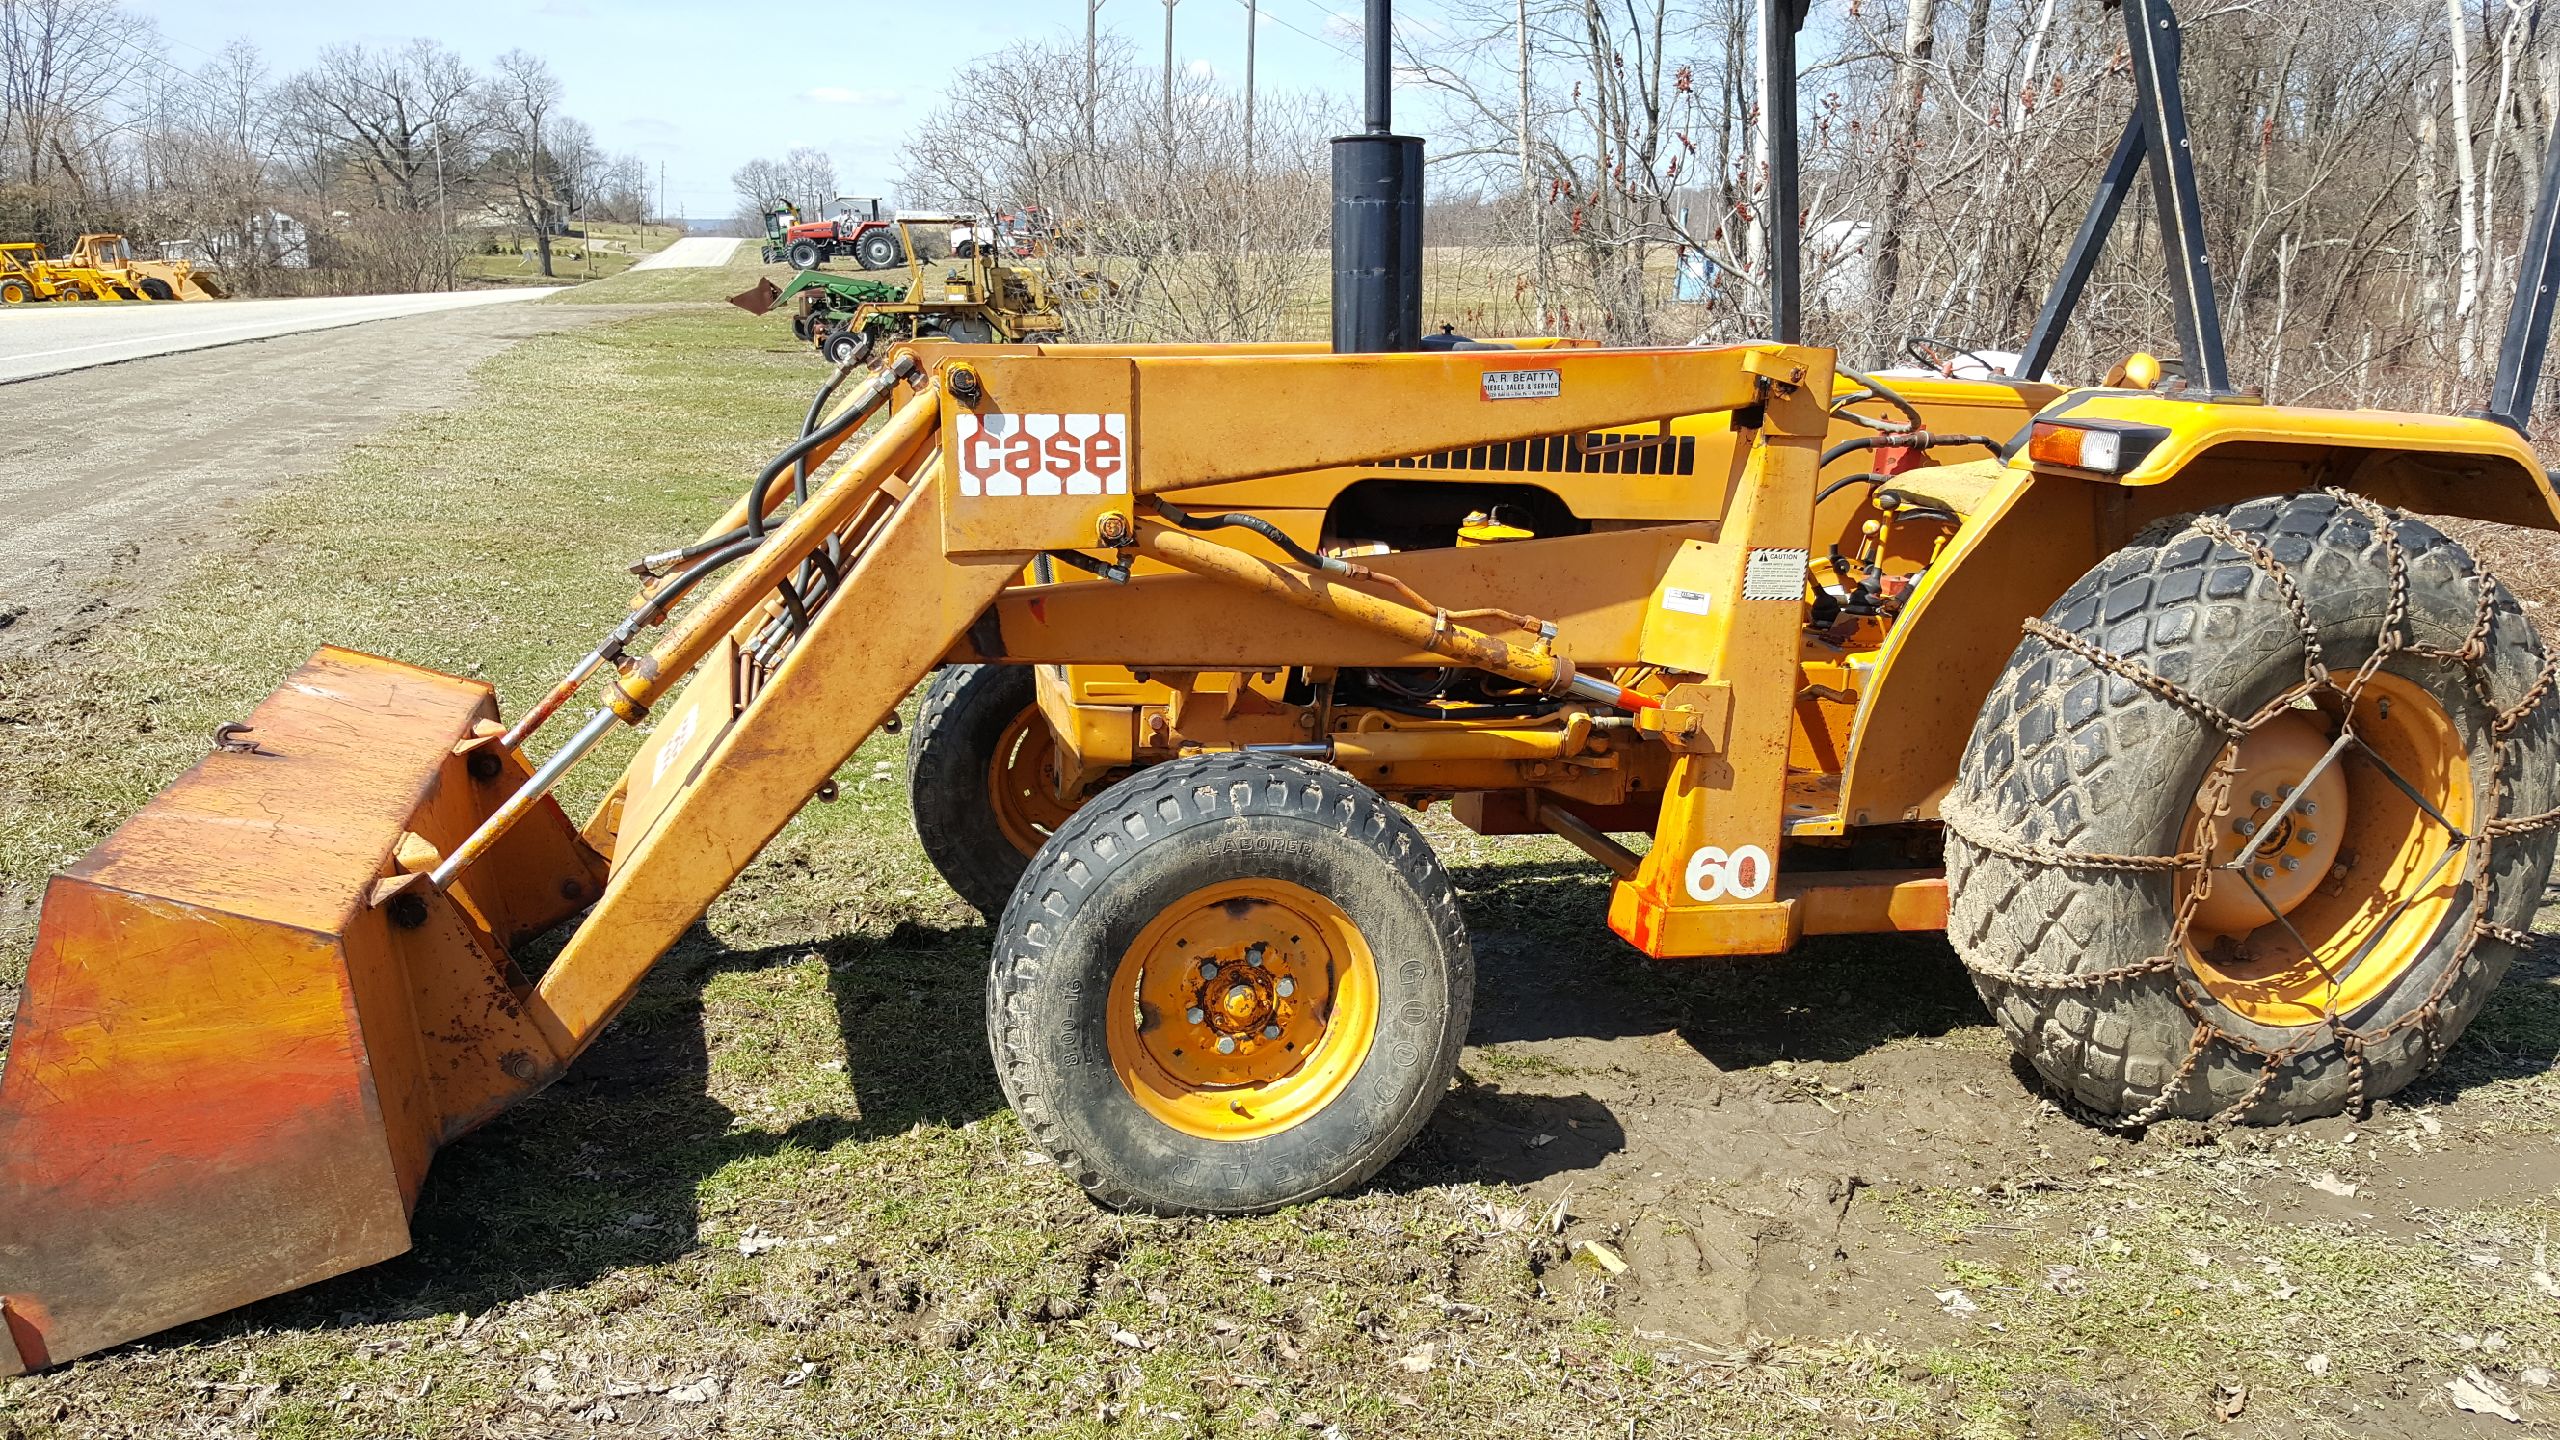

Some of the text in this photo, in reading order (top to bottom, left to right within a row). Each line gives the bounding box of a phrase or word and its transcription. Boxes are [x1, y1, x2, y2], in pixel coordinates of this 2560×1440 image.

[1513, 372, 1553, 382] BEATTY
[1206, 837, 1314, 857] LABORER
[1685, 844, 1770, 902] 60
[1061, 978, 1083, 1067] 8.00-16
